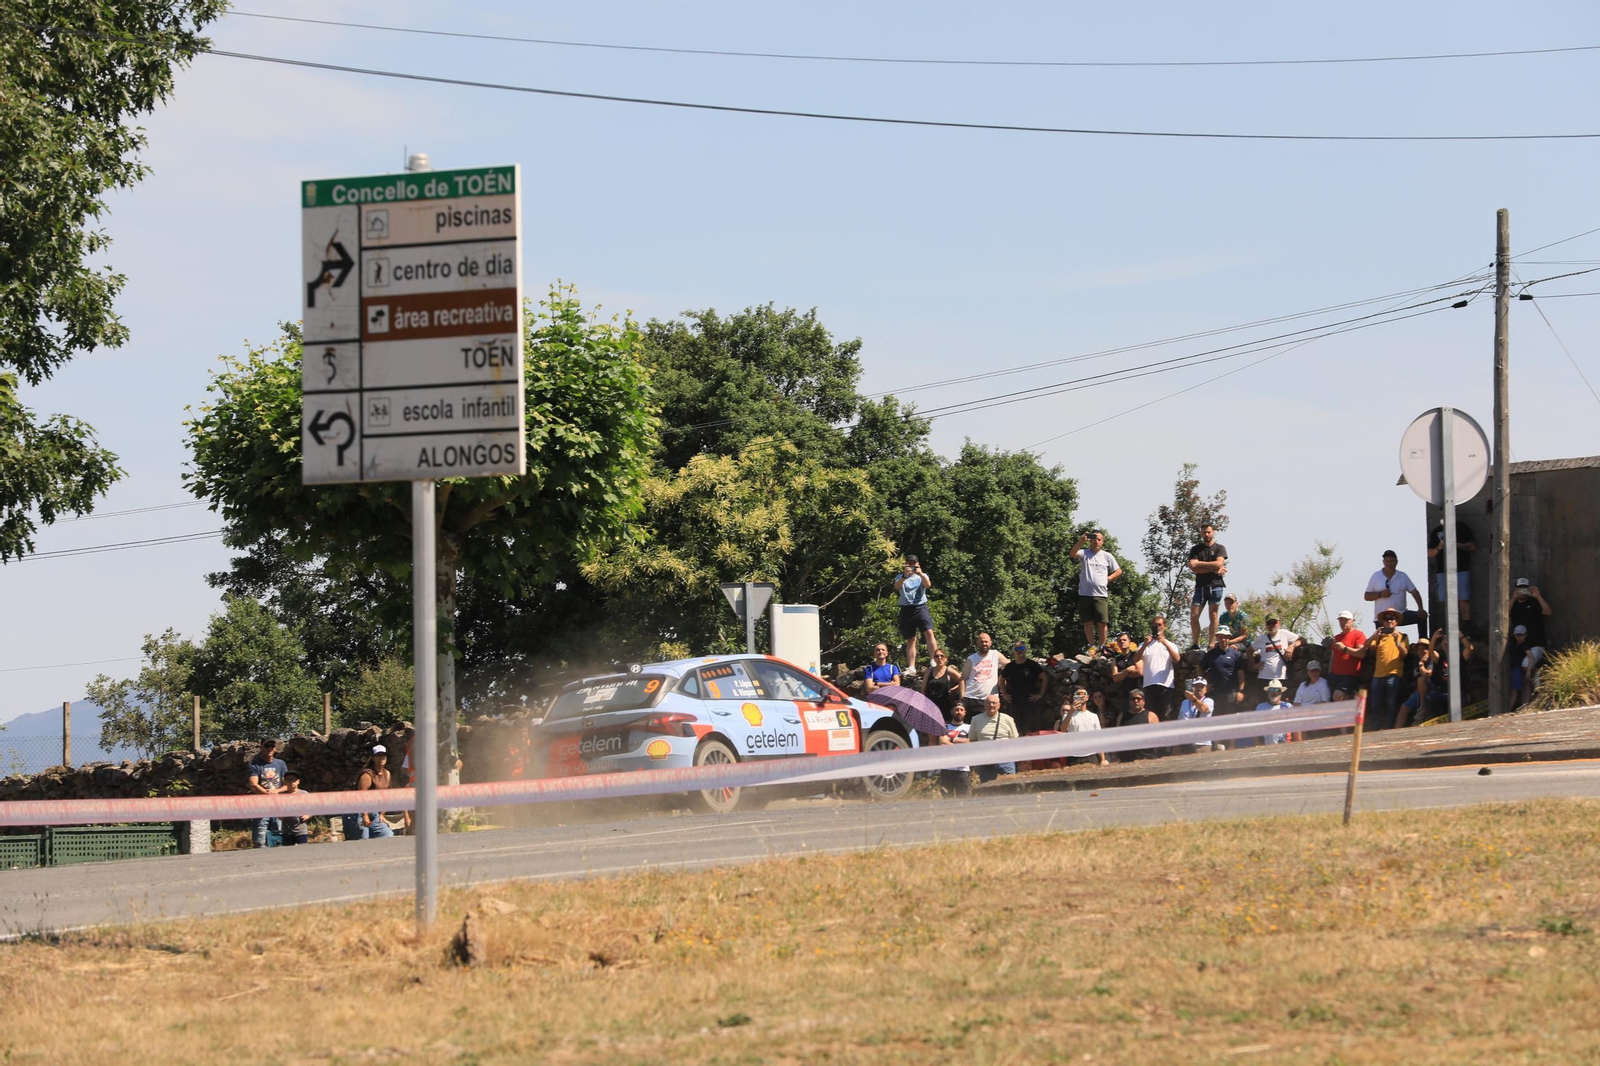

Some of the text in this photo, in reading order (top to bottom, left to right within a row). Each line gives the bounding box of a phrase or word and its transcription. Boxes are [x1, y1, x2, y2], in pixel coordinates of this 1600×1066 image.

[332, 169, 513, 204] Concello de TOÉN
[436, 205, 513, 234] piscinas
[393, 253, 514, 281] centro de día
[394, 302, 514, 330] área recreativa
[402, 395, 515, 422] escola infantil
[417, 443, 516, 468] ALONGOS
[643, 679, 661, 694] 9
[708, 680, 722, 699] 9
[839, 712, 849, 727] 9
[558, 735, 622, 758] cetelem
[745, 728, 799, 752] cetelem
